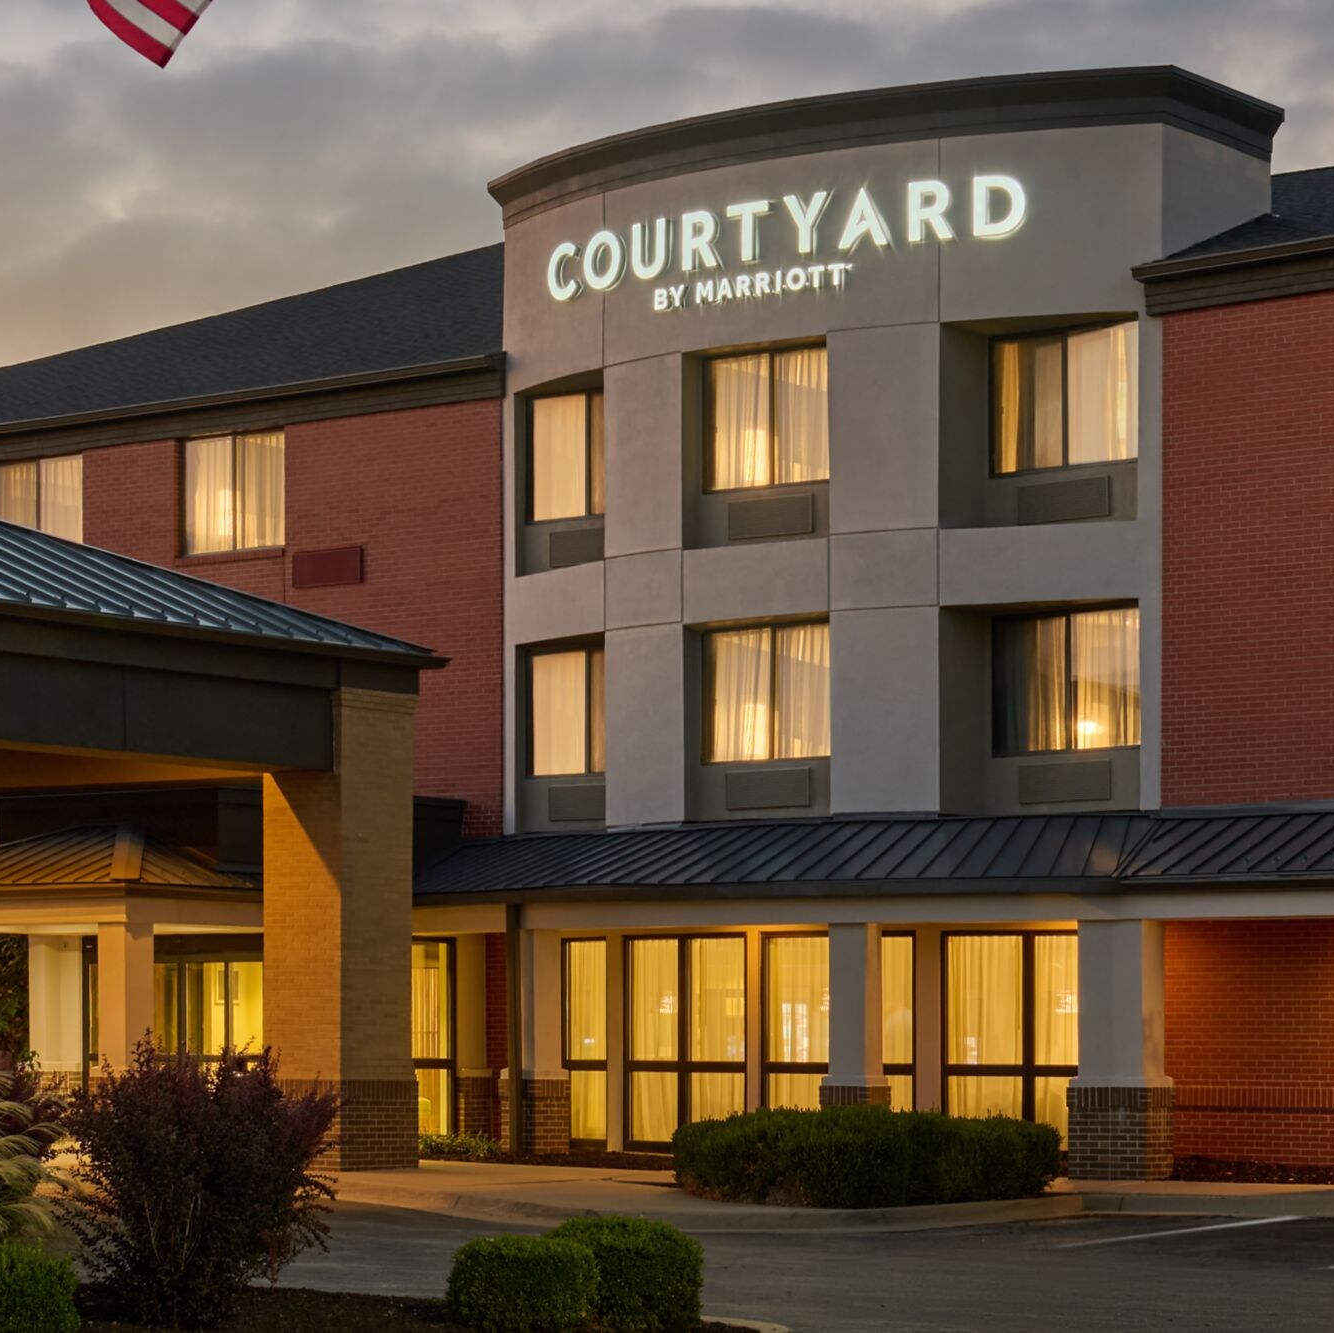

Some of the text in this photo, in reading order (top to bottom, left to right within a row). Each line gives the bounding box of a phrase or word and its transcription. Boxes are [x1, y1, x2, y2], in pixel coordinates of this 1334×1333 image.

[547, 175, 1028, 302] COURTYARD
[653, 263, 849, 311] BY MARRIOTT
